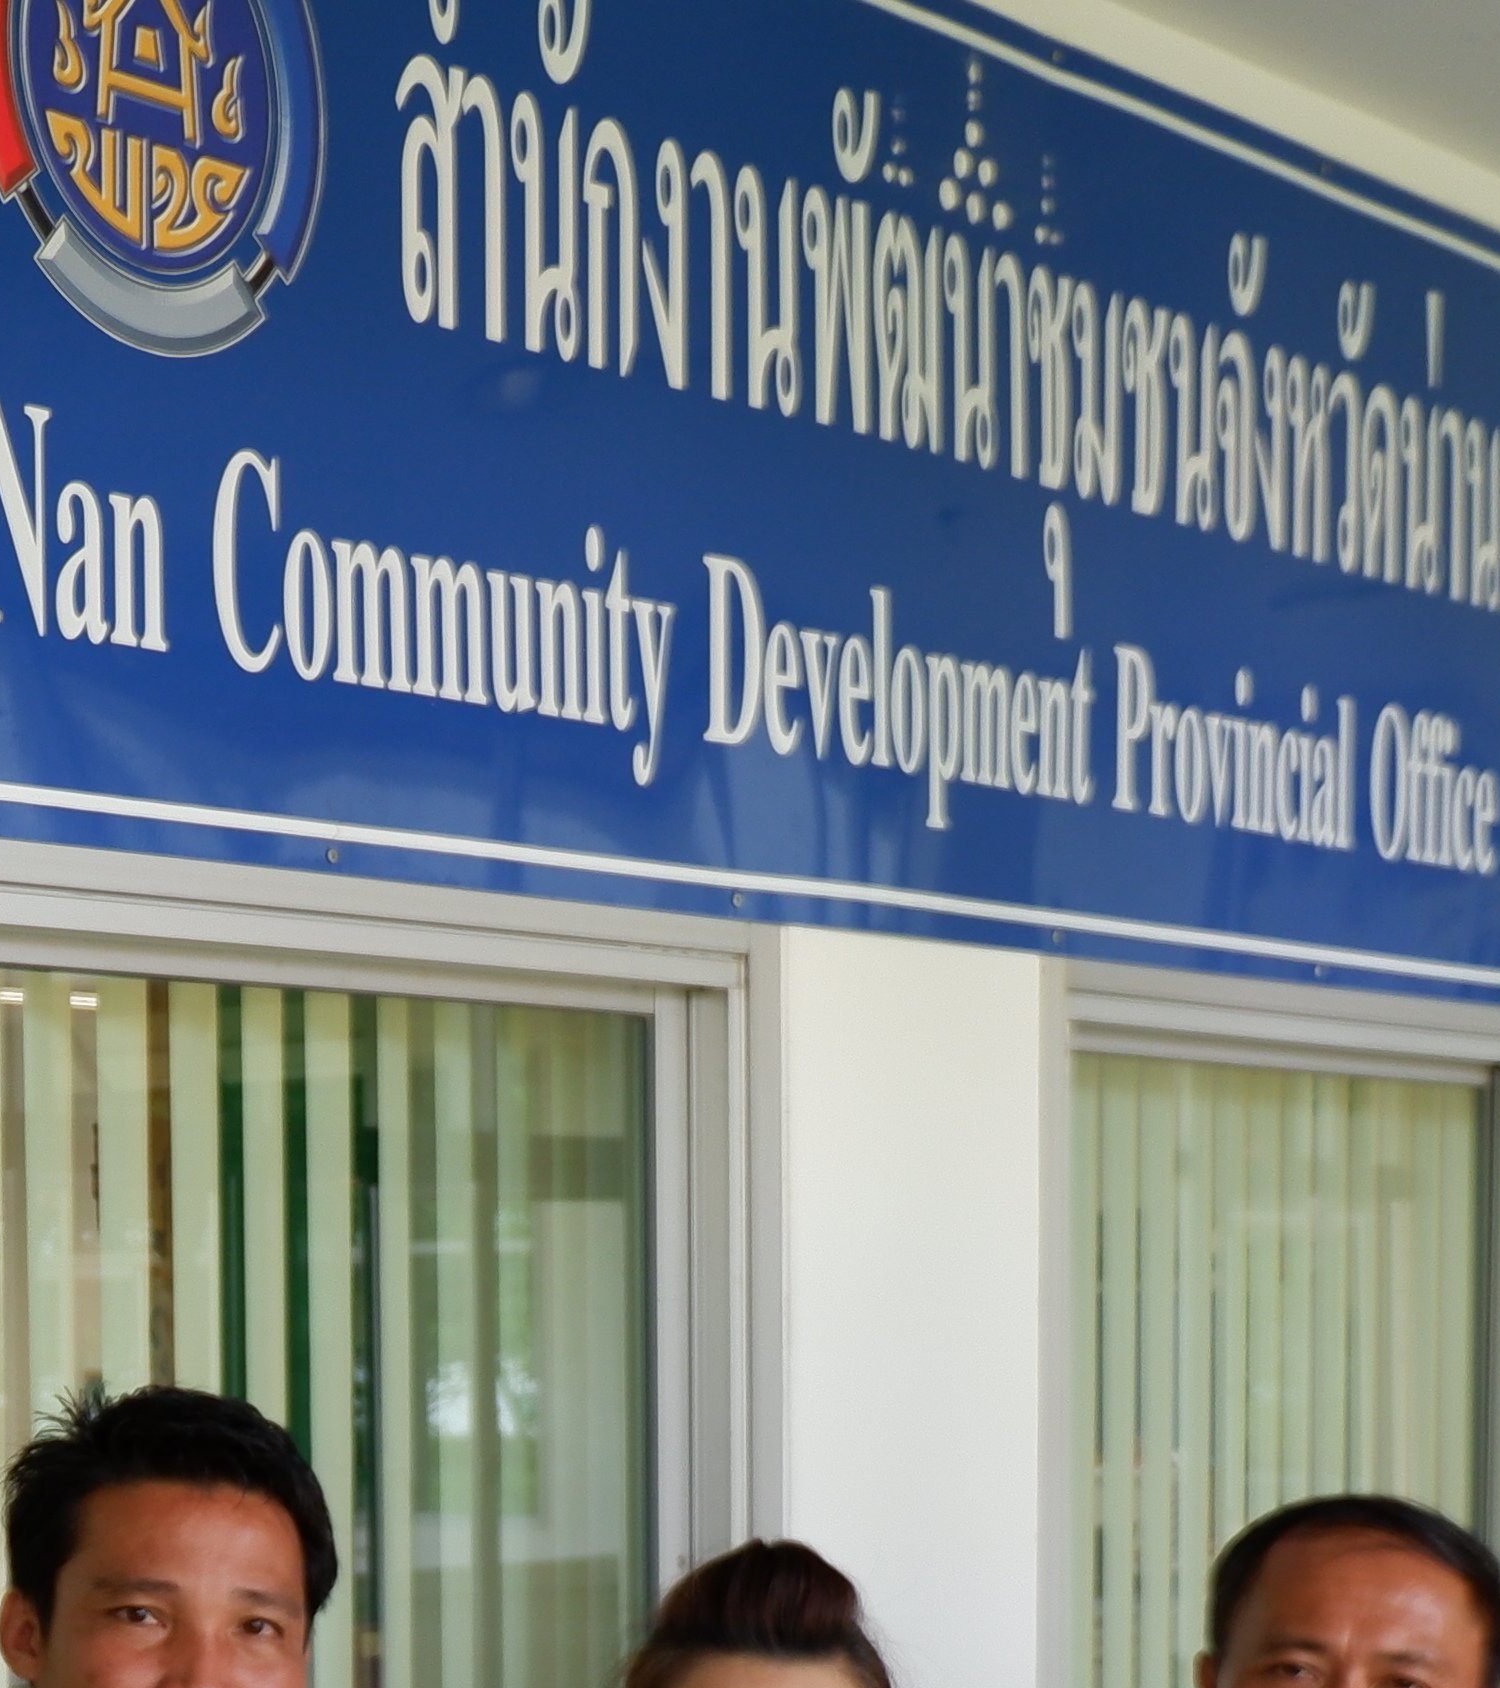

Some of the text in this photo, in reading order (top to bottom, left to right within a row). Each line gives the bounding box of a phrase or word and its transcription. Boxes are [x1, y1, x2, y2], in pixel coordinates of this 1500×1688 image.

[212, 448, 675, 787] Community
[701, 552, 1094, 831] Development
[1110, 642, 1356, 852] Provincial
